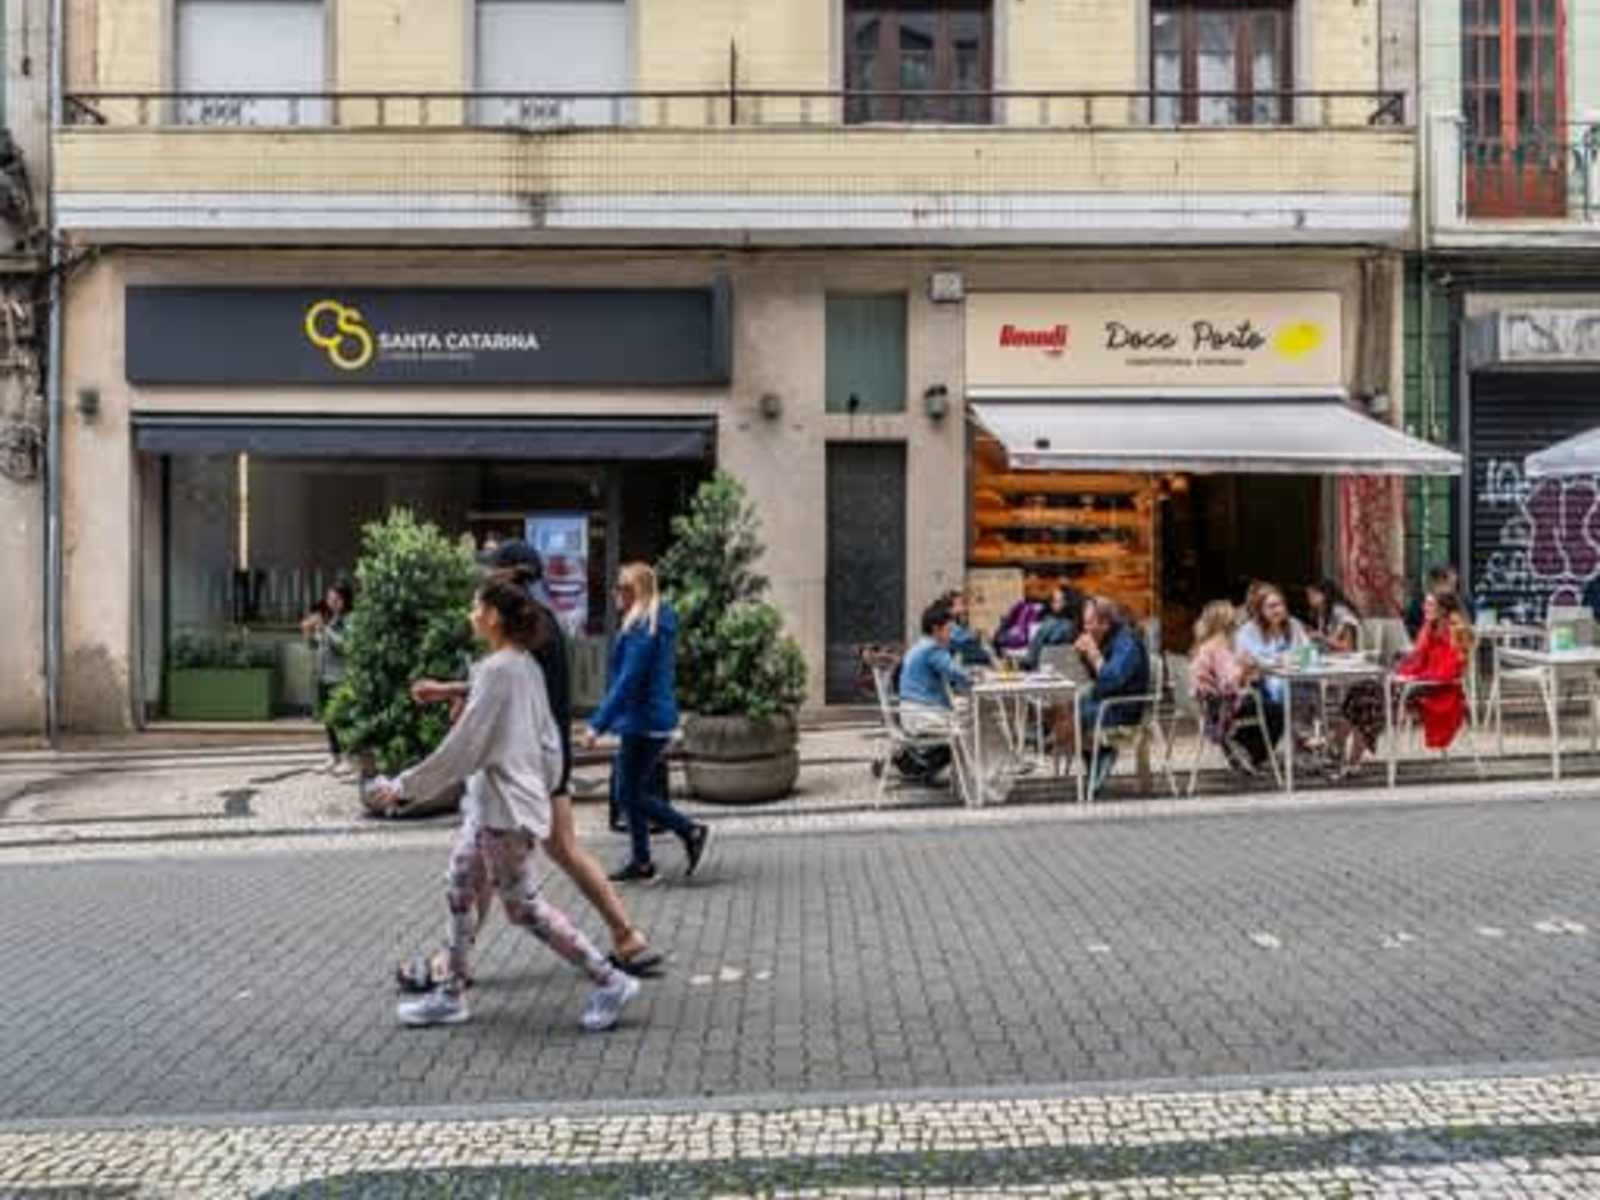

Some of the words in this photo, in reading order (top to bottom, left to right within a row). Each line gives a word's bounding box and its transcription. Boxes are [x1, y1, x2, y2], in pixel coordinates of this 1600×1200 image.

[378, 332, 441, 350] SANTA
[446, 332, 539, 350] CATARINA
[1105, 321, 1177, 350] Doce
[1193, 319, 1267, 351] Porto
